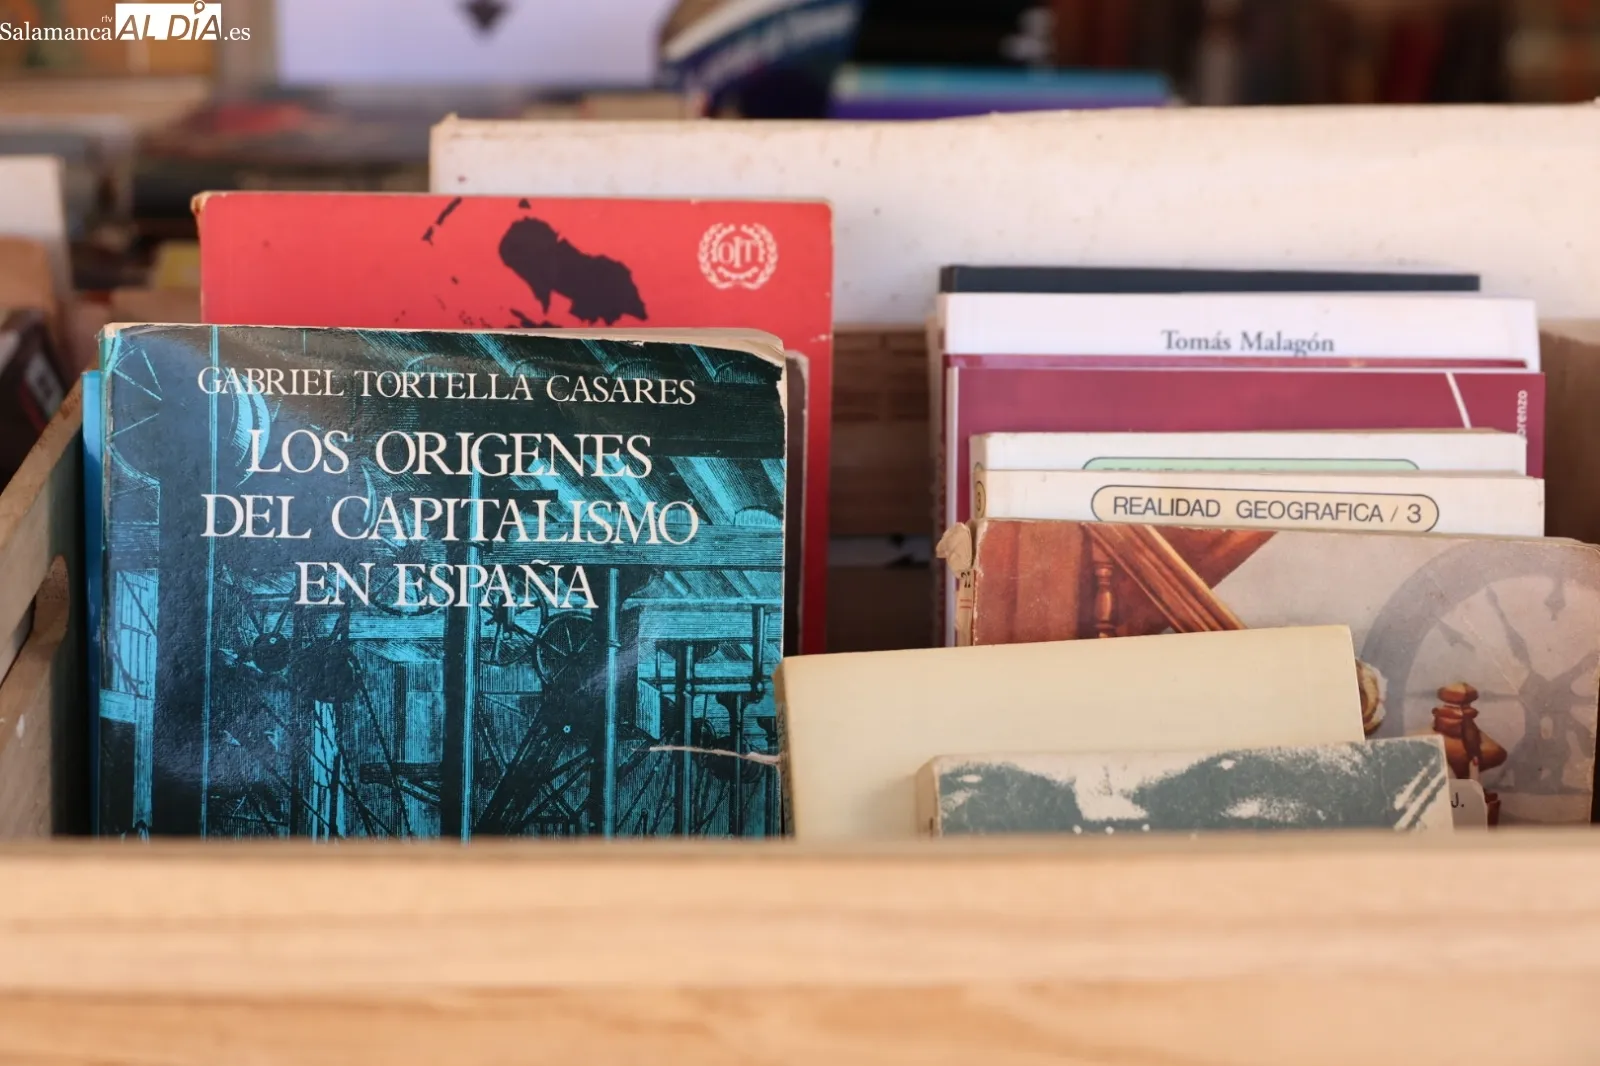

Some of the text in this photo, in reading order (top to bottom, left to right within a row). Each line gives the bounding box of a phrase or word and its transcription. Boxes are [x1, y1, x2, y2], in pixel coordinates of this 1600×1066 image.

[1161, 329, 1335, 357] Tomás Malagón
[197, 366, 696, 405] GABRIEL TORTELLA CASARES
[246, 429, 653, 478] LOS ORIGENES
[200, 493, 699, 545] DEL CAPITALISMO
[1113, 496, 1221, 518] REALIDAD
[1236, 500, 1384, 523] GEOGRAFICA
[294, 559, 599, 609] EN ESPAÑA
